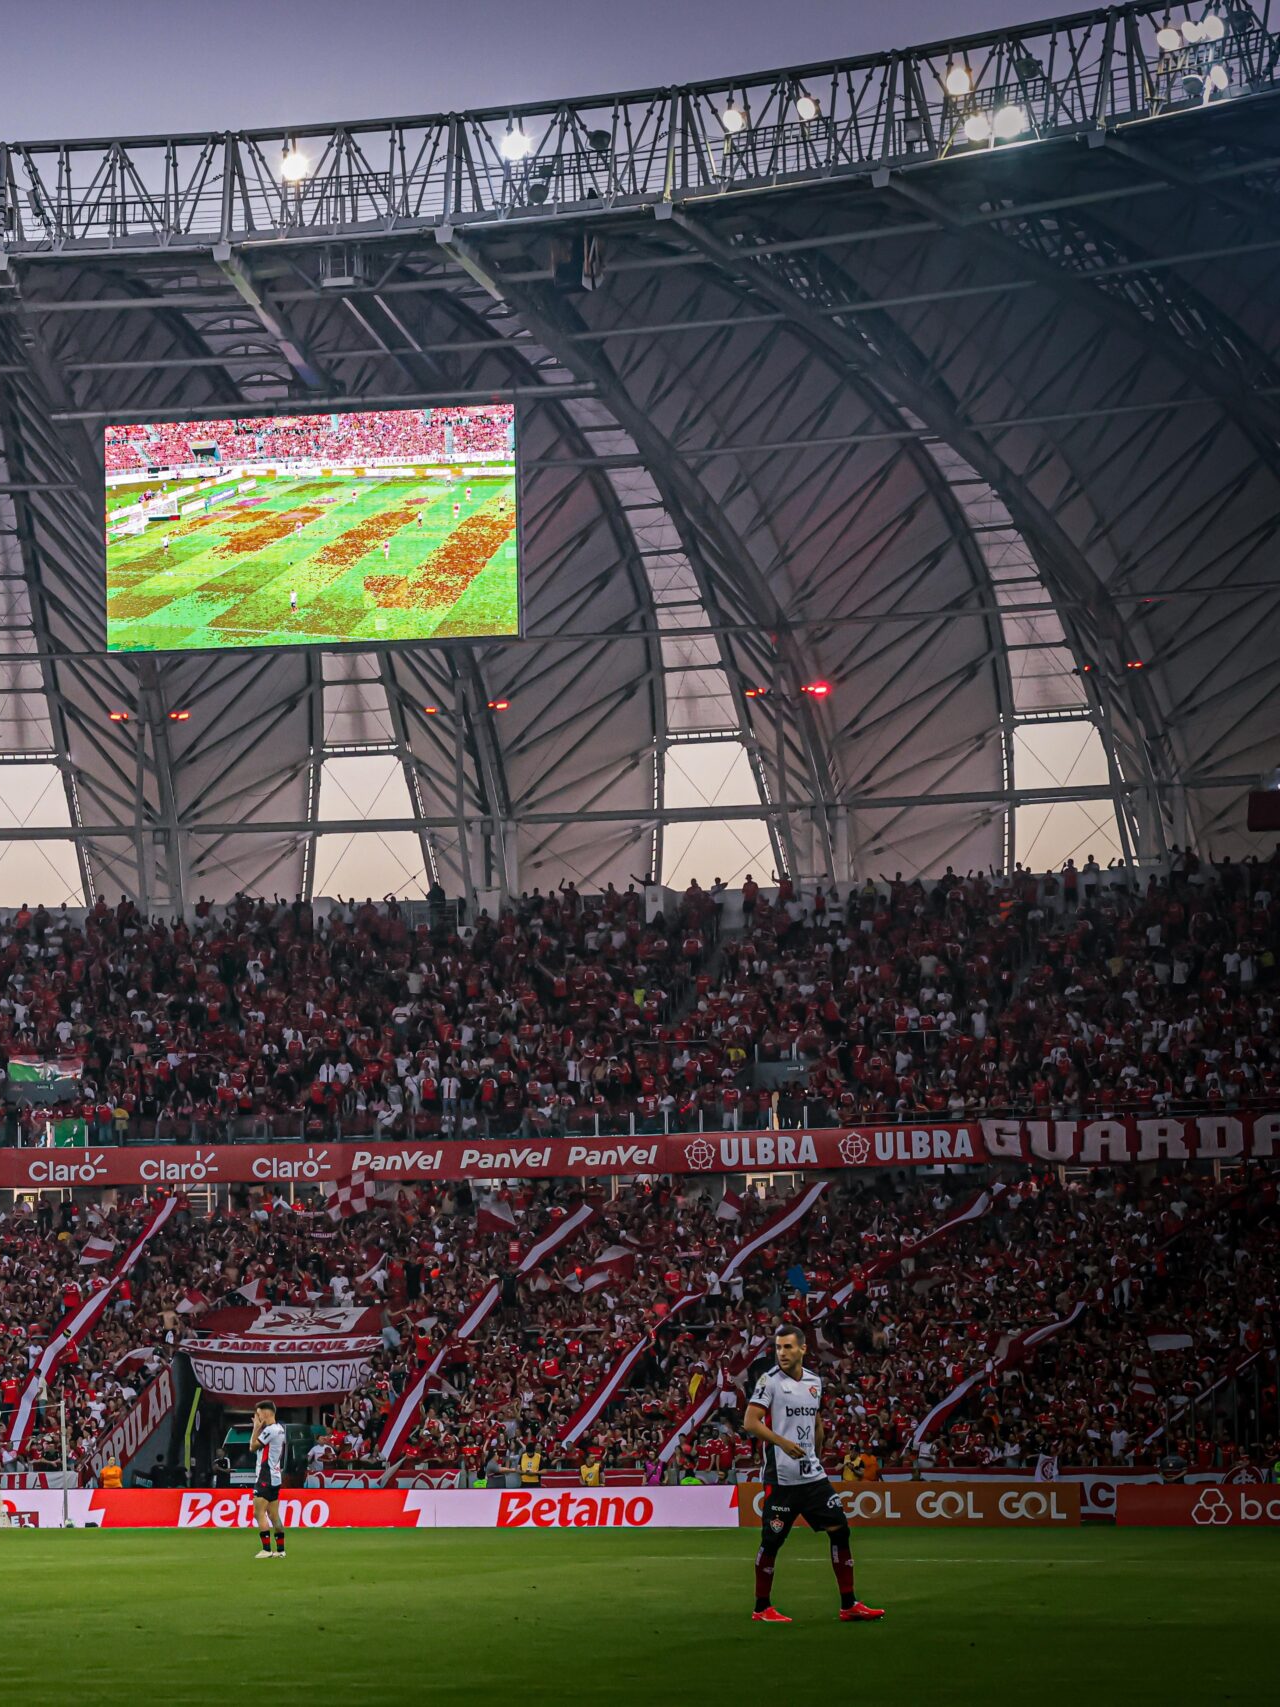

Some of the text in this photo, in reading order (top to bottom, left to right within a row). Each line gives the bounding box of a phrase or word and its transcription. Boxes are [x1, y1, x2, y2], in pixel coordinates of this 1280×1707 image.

[460, 1147, 551, 1170] PanVel
[567, 1145, 658, 1166] PanVel
[720, 1135, 818, 1166] ULBRA
[874, 1128, 974, 1161] ULBRA
[28, 1160, 96, 1182] Claro
[139, 1158, 207, 1180] Claro
[252, 1156, 319, 1179] Claro
[351, 1150, 443, 1171] PanVel
[217, 1340, 272, 1351] PADRE
[273, 1338, 350, 1353] CACIQUE,
[194, 1362, 370, 1393] FOGO NOS RACISTAS
[178, 1492, 330, 1527] Betno
[496, 1491, 654, 1527] Betano
[838, 1490, 901, 1520] GOL
[915, 1490, 984, 1520] GOL
[998, 1490, 1067, 1520] GOL
